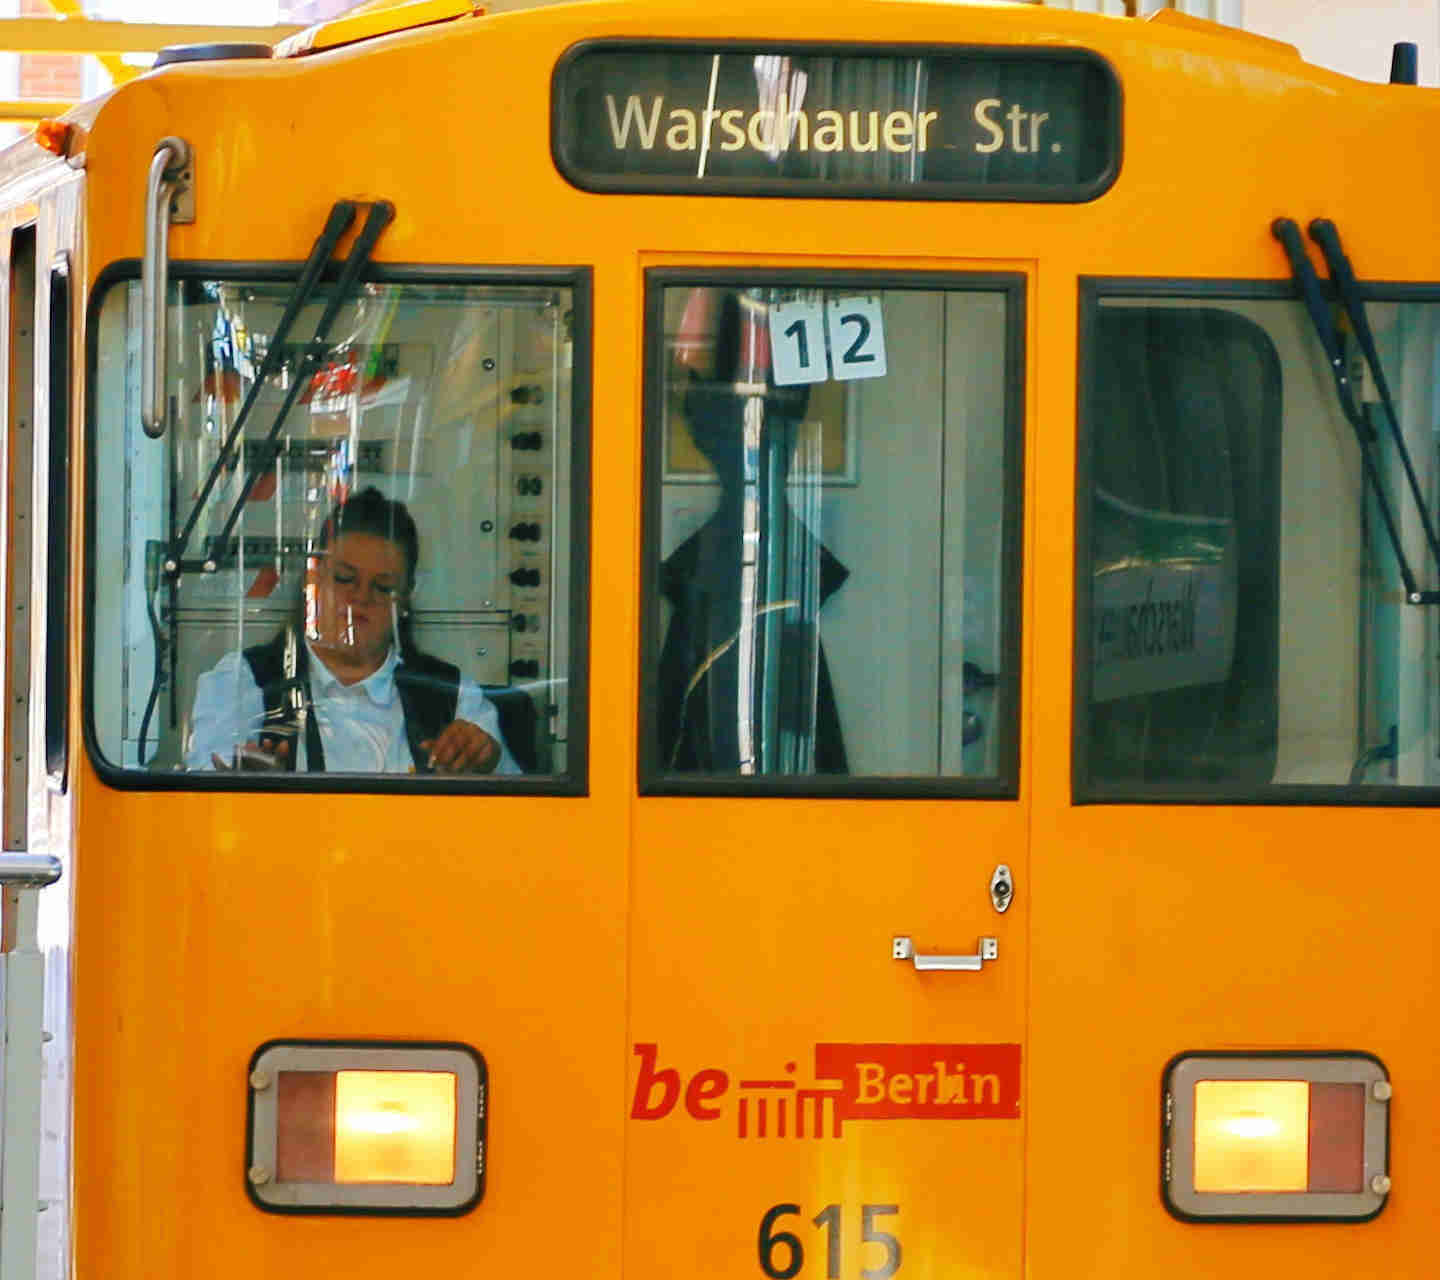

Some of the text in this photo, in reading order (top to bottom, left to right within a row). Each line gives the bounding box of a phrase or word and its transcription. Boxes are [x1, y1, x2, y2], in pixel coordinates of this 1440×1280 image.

[604, 92, 1062, 155] Warschauer Str.
[855, 1061, 1001, 1106] Berlin
[757, 1203, 903, 1280] 615
